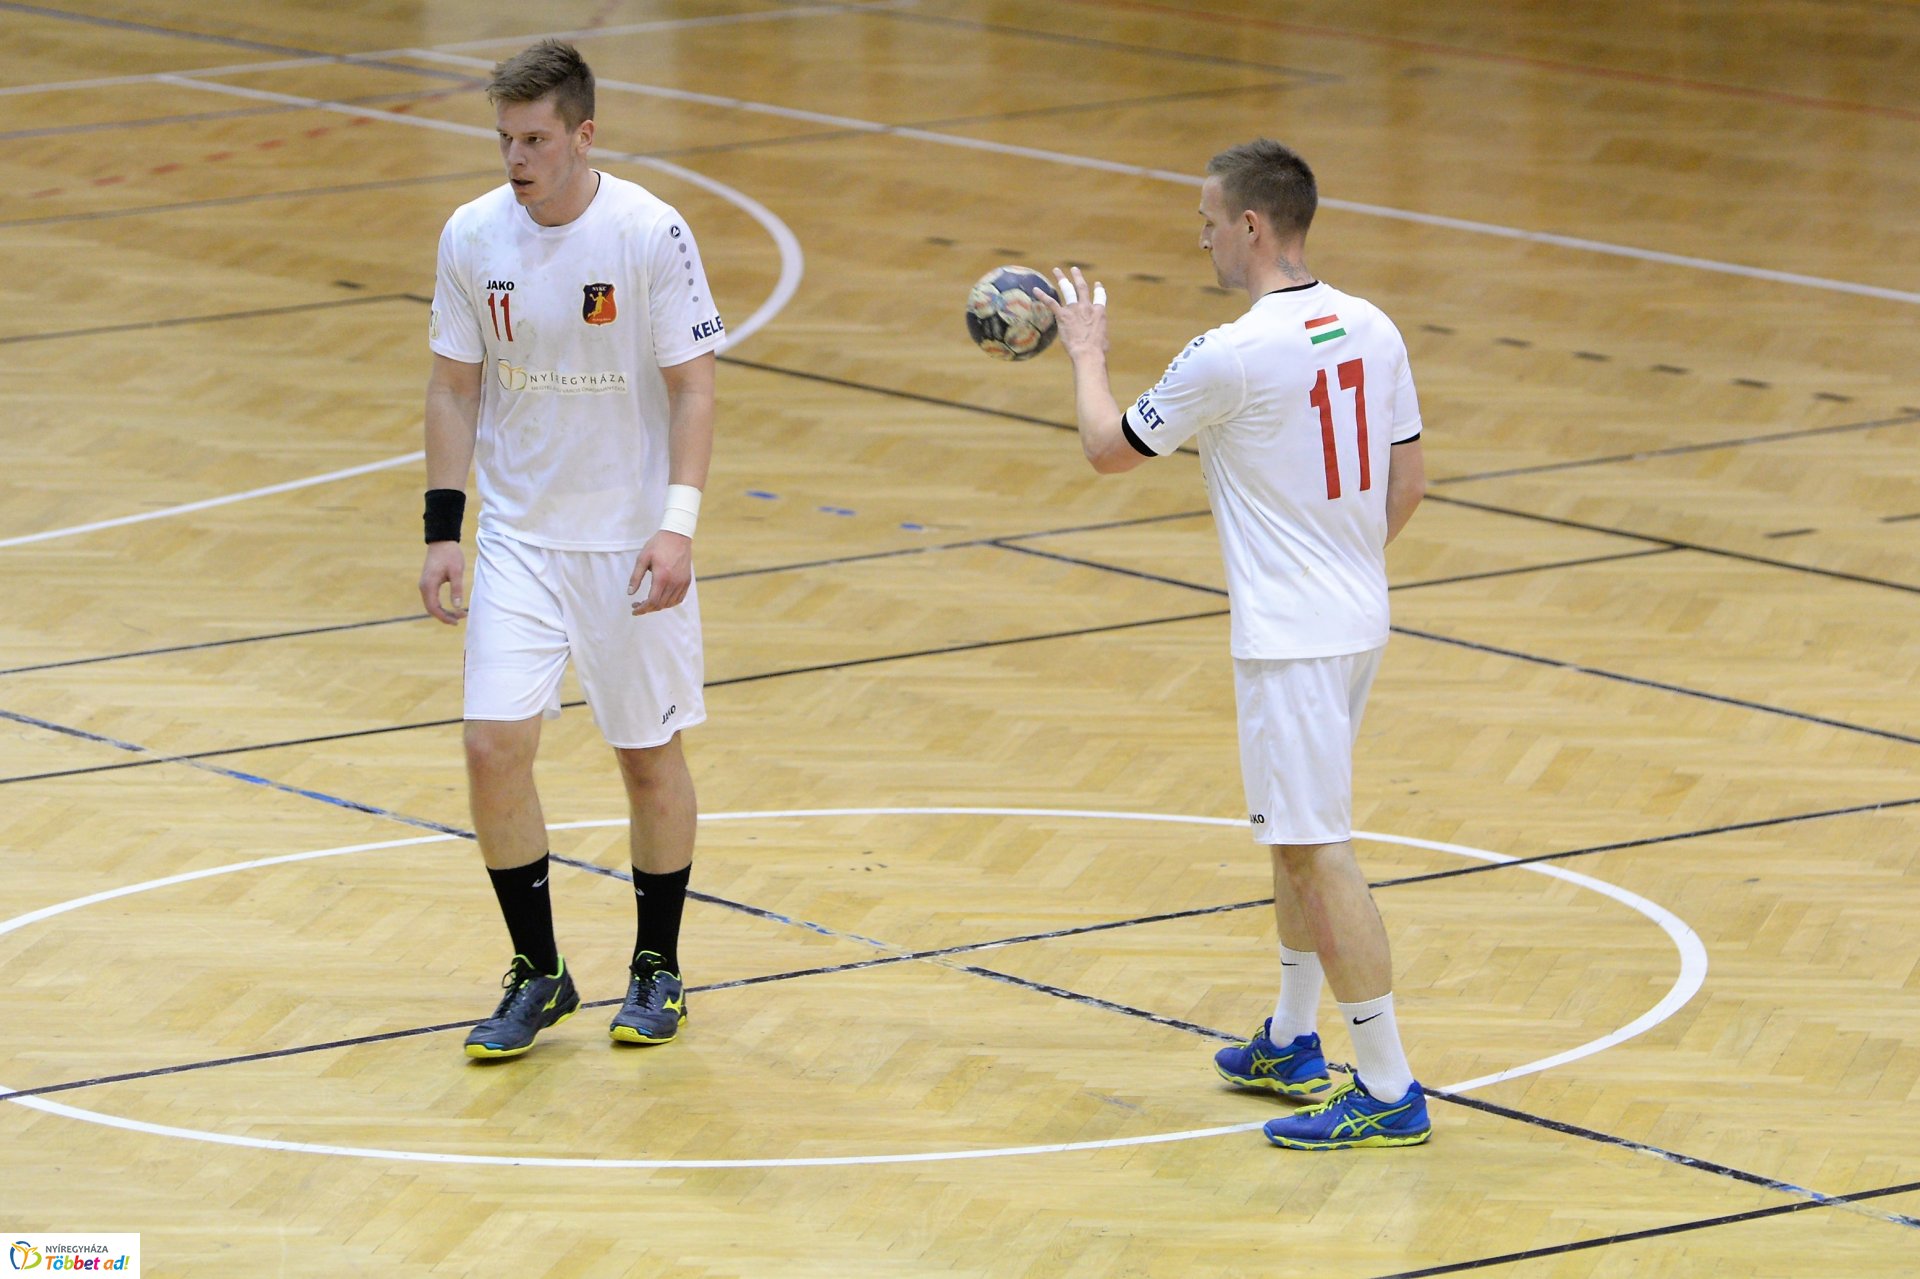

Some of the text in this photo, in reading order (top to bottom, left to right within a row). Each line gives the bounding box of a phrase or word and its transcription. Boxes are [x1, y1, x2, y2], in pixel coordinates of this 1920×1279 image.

[486, 280, 515, 291] JAKO
[487, 293, 514, 342] 11
[1309, 358, 1371, 500] 17
